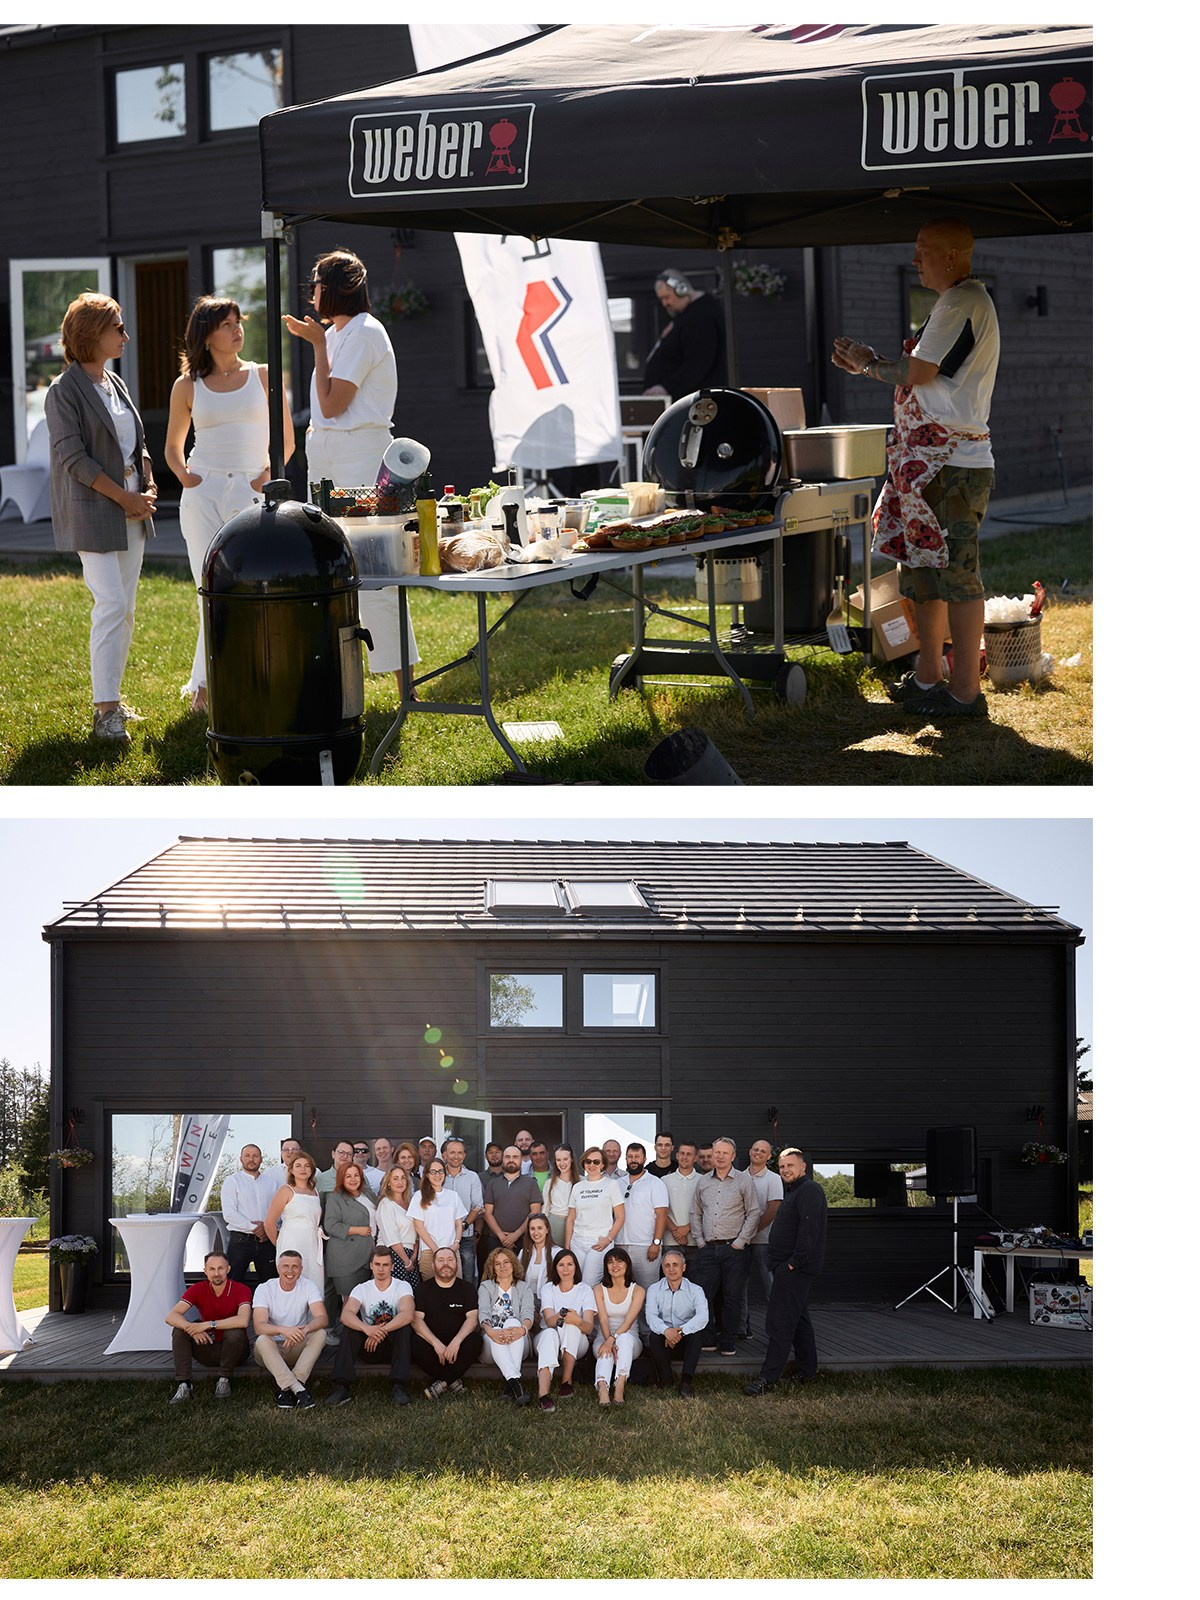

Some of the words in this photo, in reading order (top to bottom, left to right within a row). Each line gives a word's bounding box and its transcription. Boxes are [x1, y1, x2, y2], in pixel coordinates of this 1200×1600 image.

[362, 112, 483, 184] weber
[878, 71, 1040, 154] weber
[188, 1131, 218, 1204] OUSE
